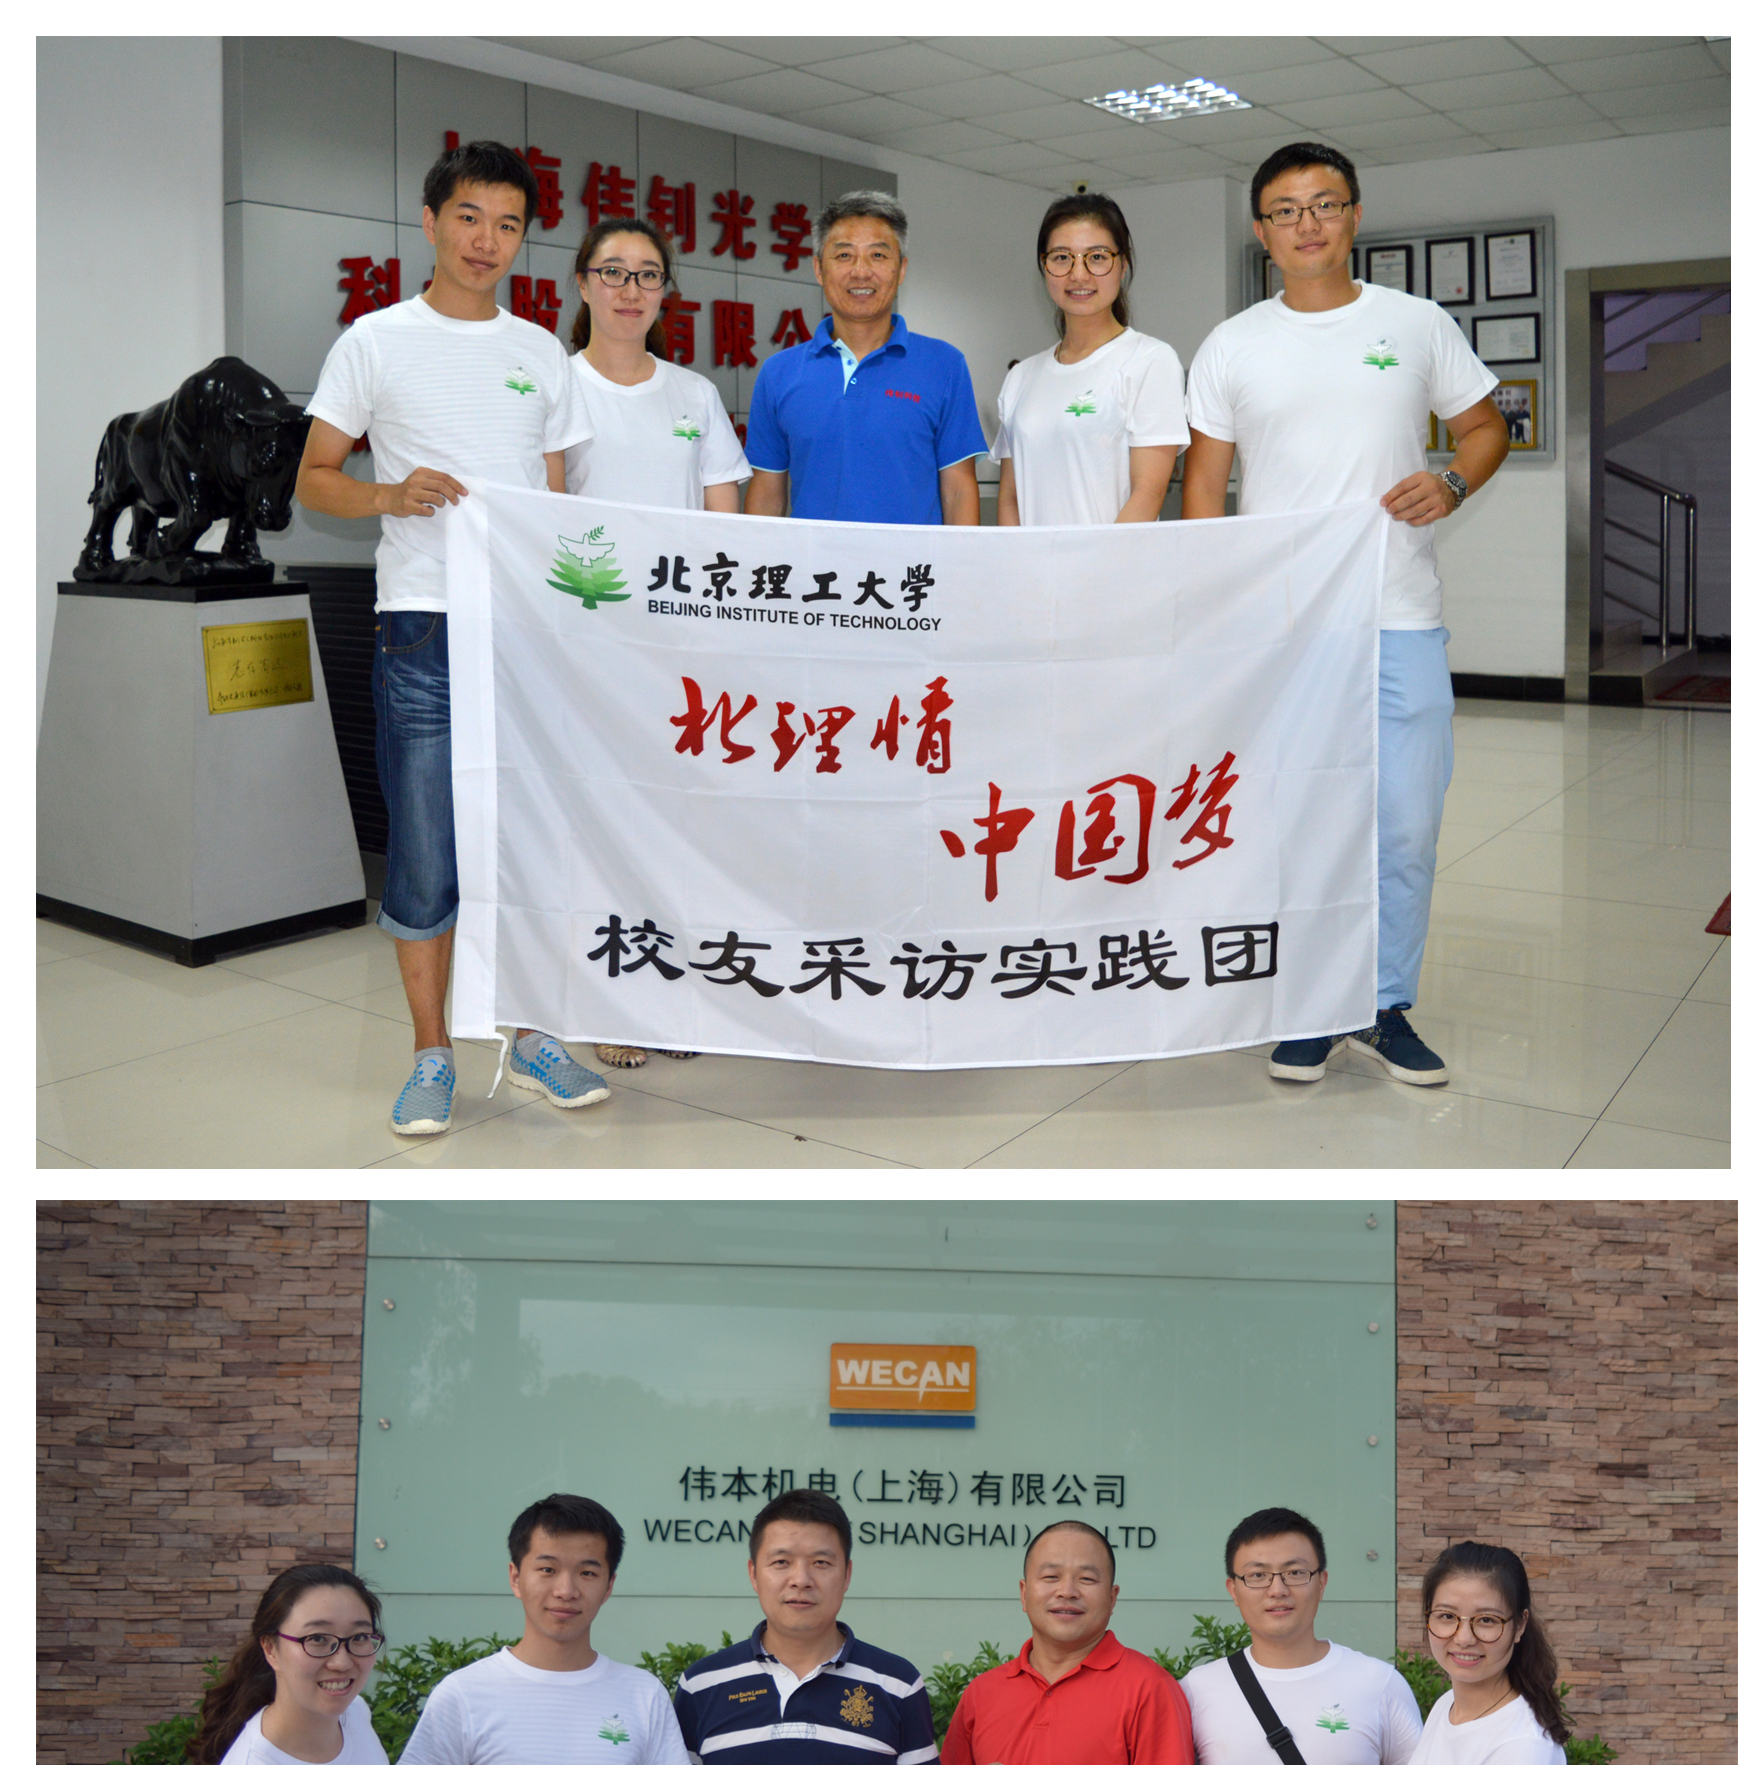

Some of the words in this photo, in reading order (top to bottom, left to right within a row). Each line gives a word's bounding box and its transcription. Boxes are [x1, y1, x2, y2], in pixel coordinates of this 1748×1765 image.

[648, 599, 712, 618] BEIJING
[716, 606, 799, 625] INSTITUTE
[803, 612, 825, 626] OF
[830, 613, 941, 631] TECHNOLOGY
[670, 676, 954, 774] 北理情
[940, 752, 1239, 902] 中国梦
[587, 915, 1279, 1000] 校友采访实践团
[836, 1359, 970, 1403] WECAN
[643, 1519, 752, 1543] WECAN
